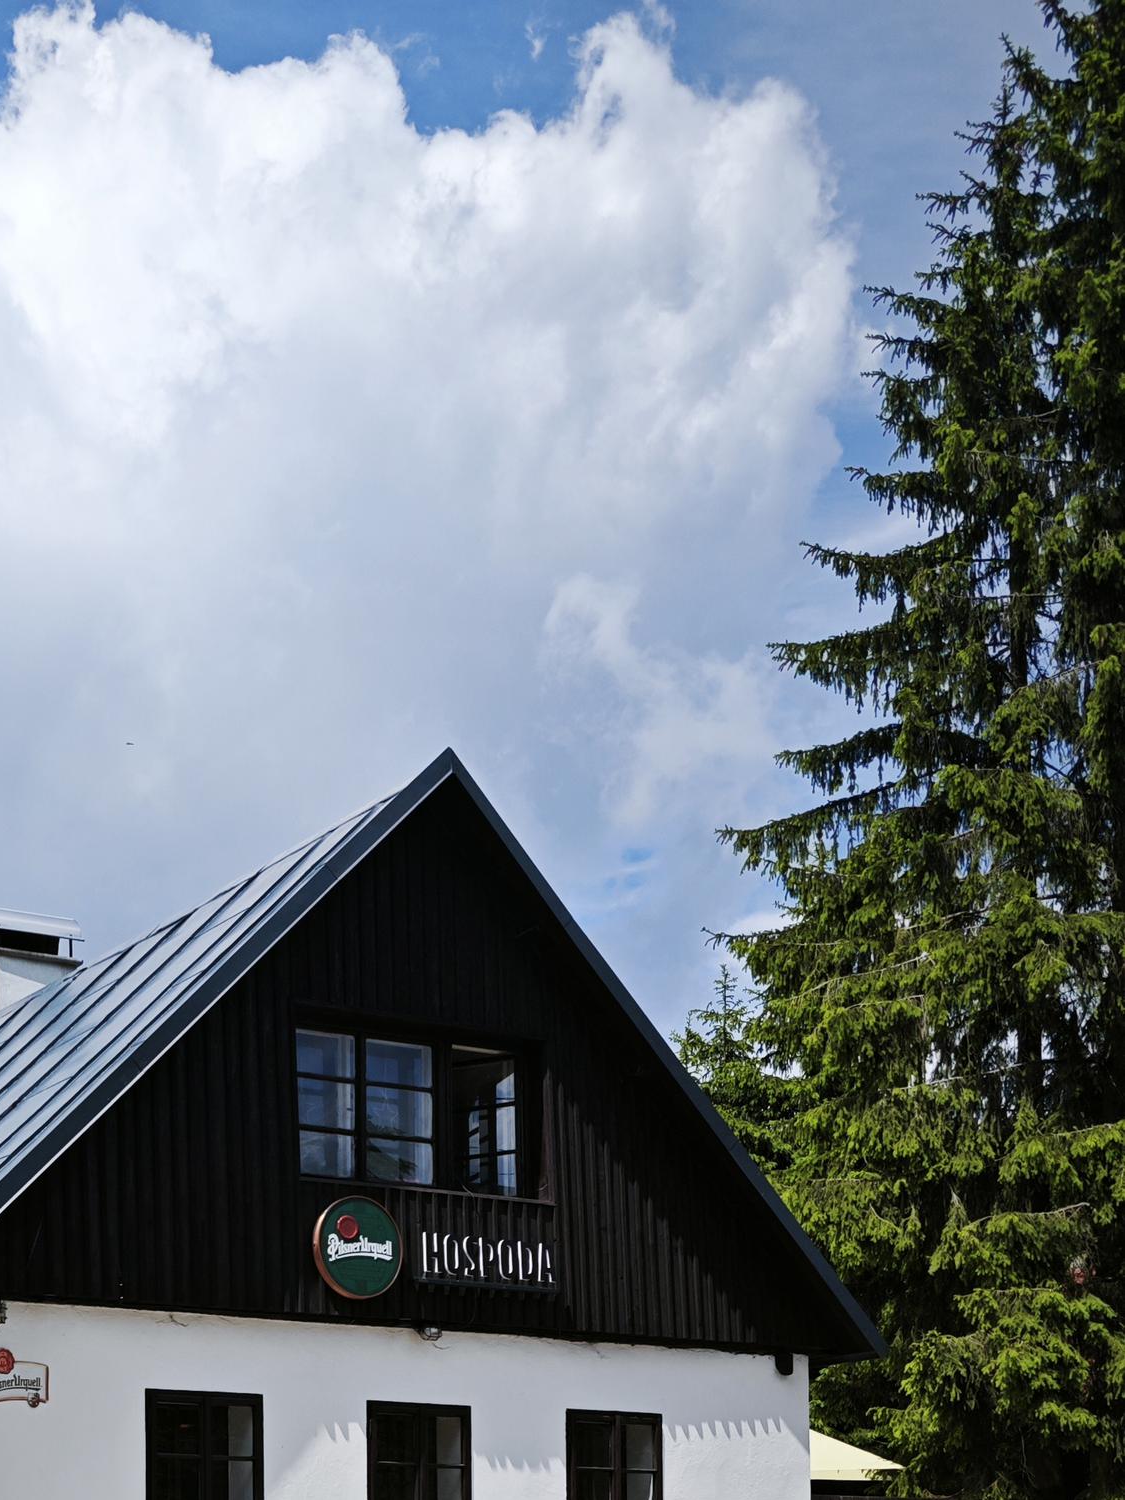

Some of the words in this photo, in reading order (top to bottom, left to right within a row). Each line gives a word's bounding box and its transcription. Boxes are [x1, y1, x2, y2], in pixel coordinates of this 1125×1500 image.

[327, 1233, 362, 1262] Pilsner
[359, 1234, 393, 1260] Urquell
[422, 1231, 556, 1283] HOSPODA
[13, 1374, 42, 1392] Urquell
